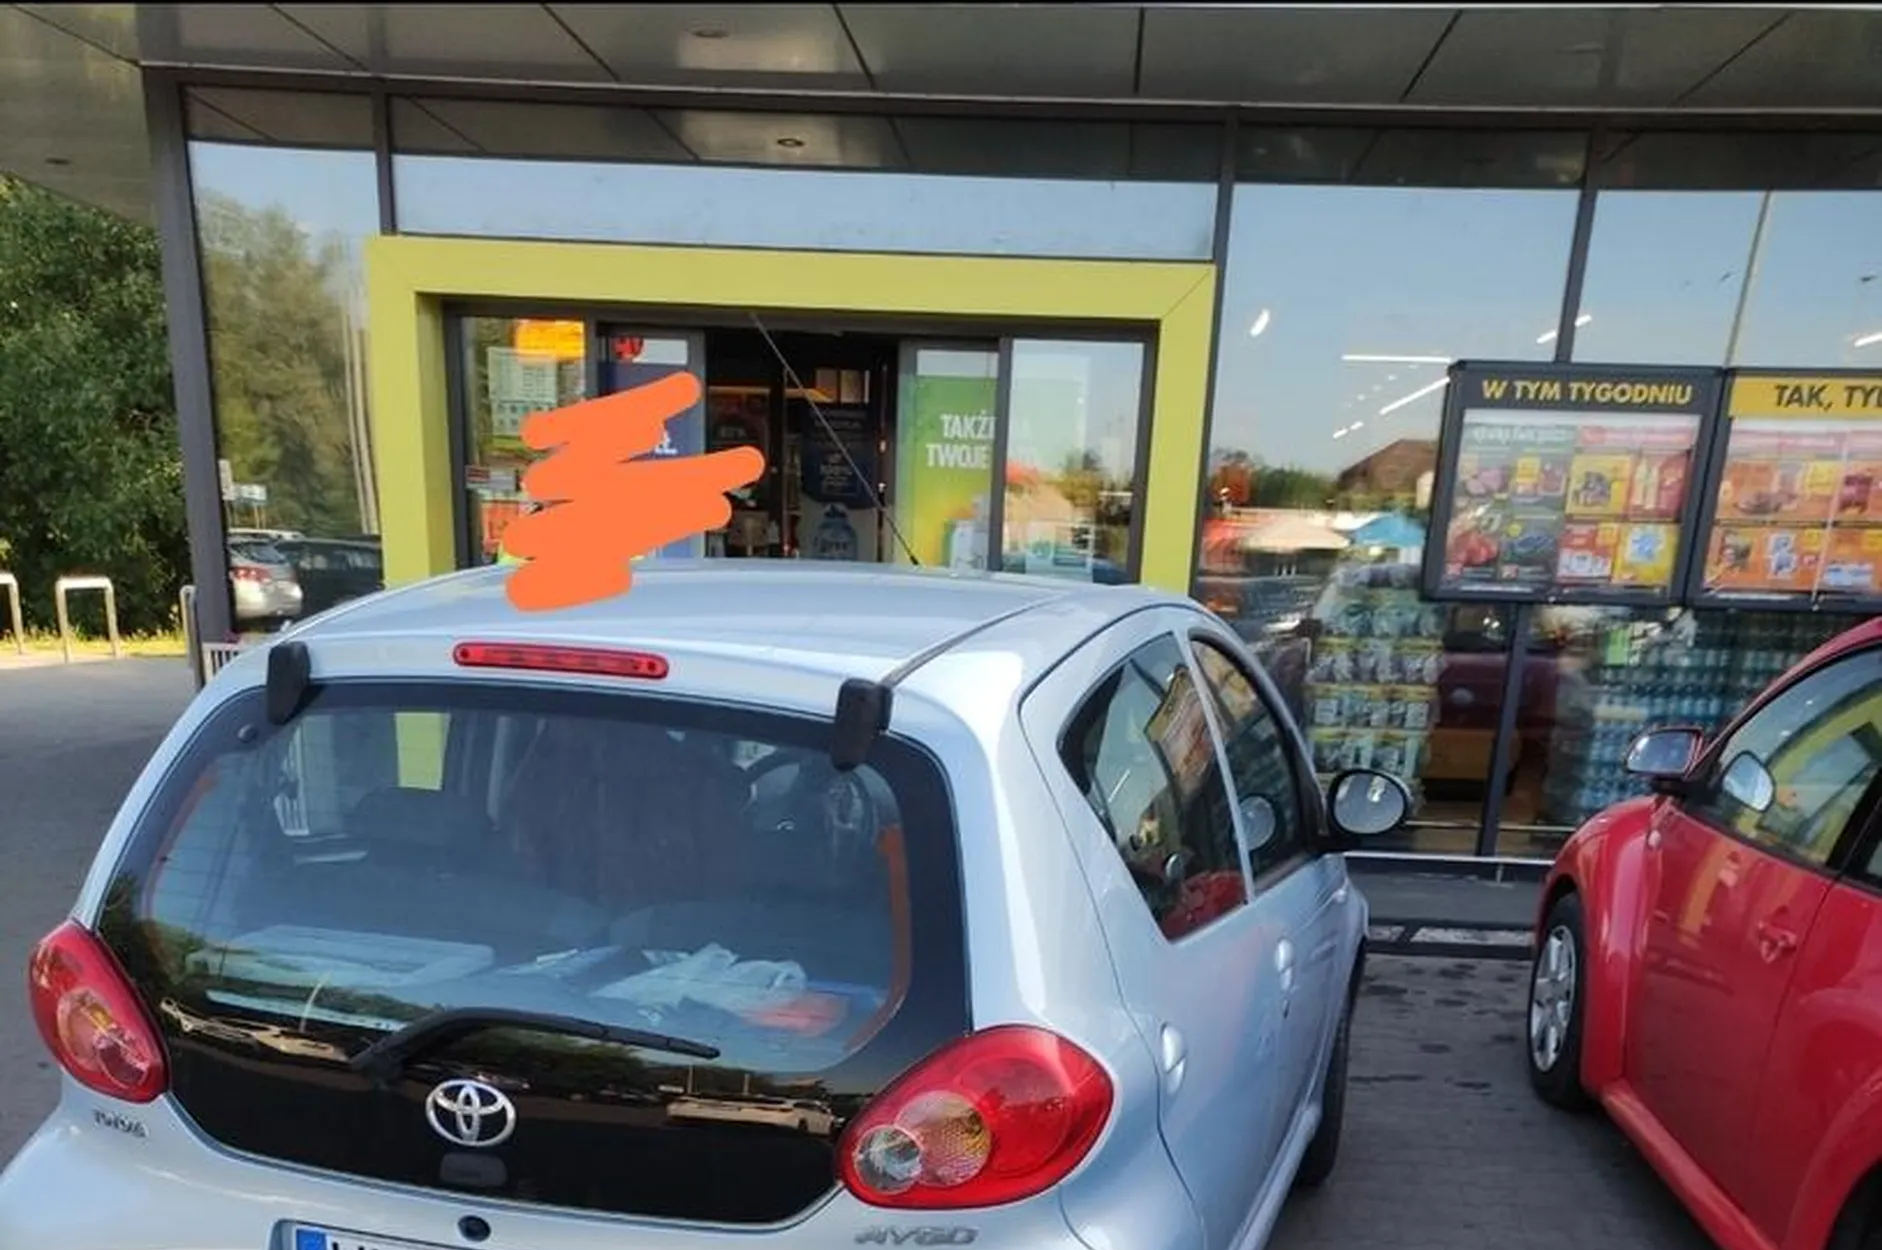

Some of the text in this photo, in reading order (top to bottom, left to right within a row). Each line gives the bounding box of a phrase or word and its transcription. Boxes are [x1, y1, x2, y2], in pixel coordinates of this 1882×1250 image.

[1482, 380, 1693, 405] W TYM TYGODNIU
[1774, 384, 1834, 412] TAK,
[926, 443, 991, 469] TWOJE
[854, 1225, 980, 1246] AYGO
